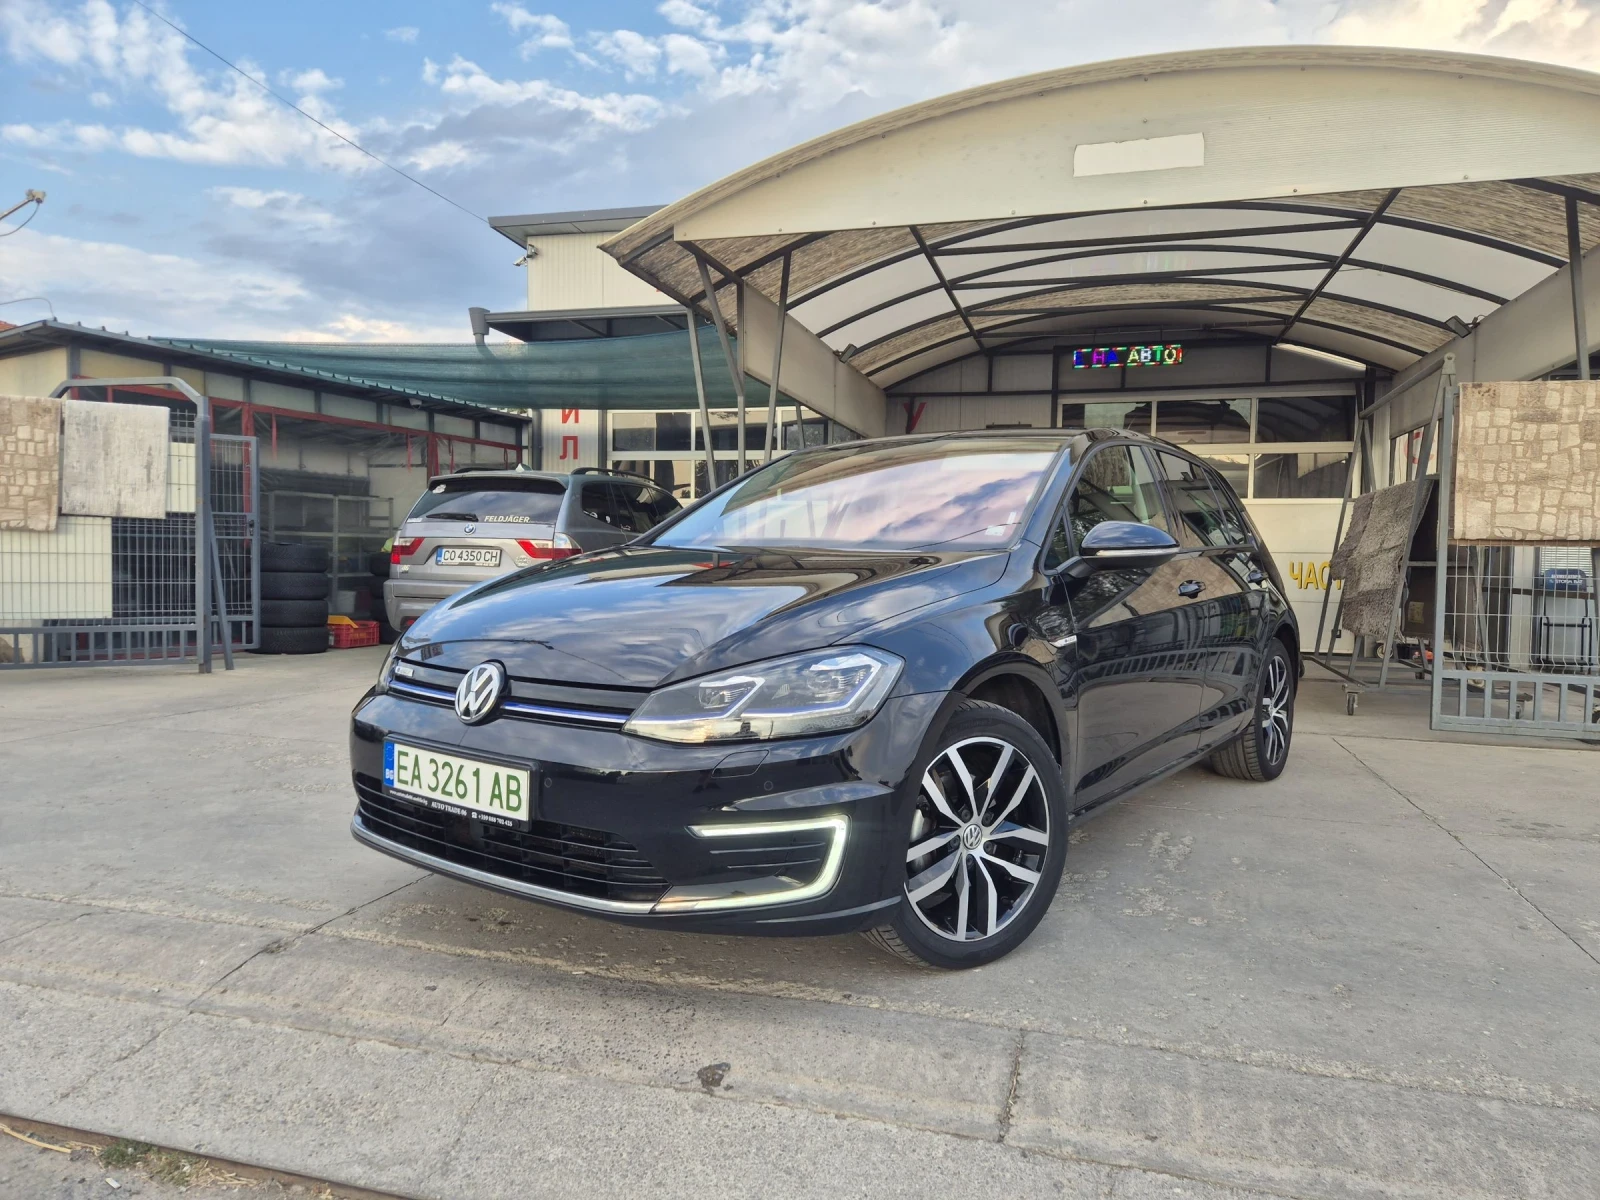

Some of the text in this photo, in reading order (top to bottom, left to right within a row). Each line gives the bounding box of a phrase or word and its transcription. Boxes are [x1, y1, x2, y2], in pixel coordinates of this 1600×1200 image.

[484, 514, 530, 523] FELDJÄGER
[443, 550, 498, 563] CO 4350 CH
[397, 750, 522, 812] EA 3261 AB
[431, 801, 445, 810] AUTO
[445, 804, 461, 815] TRADE
